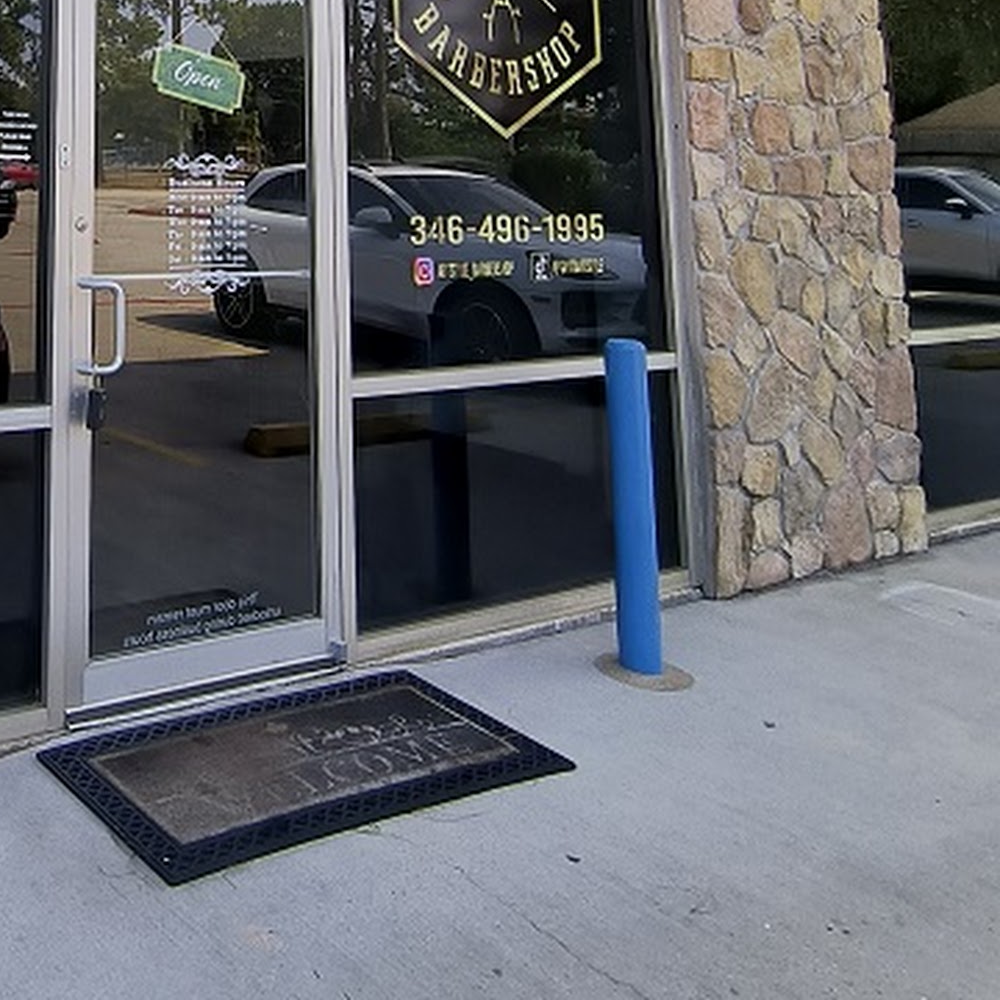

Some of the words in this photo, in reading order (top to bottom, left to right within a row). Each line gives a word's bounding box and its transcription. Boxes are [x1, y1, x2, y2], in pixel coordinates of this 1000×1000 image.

[413, 1, 582, 97] BARBERSHOP
[174, 60, 223, 91] Open
[409, 213, 605, 246] 346-496-1995
